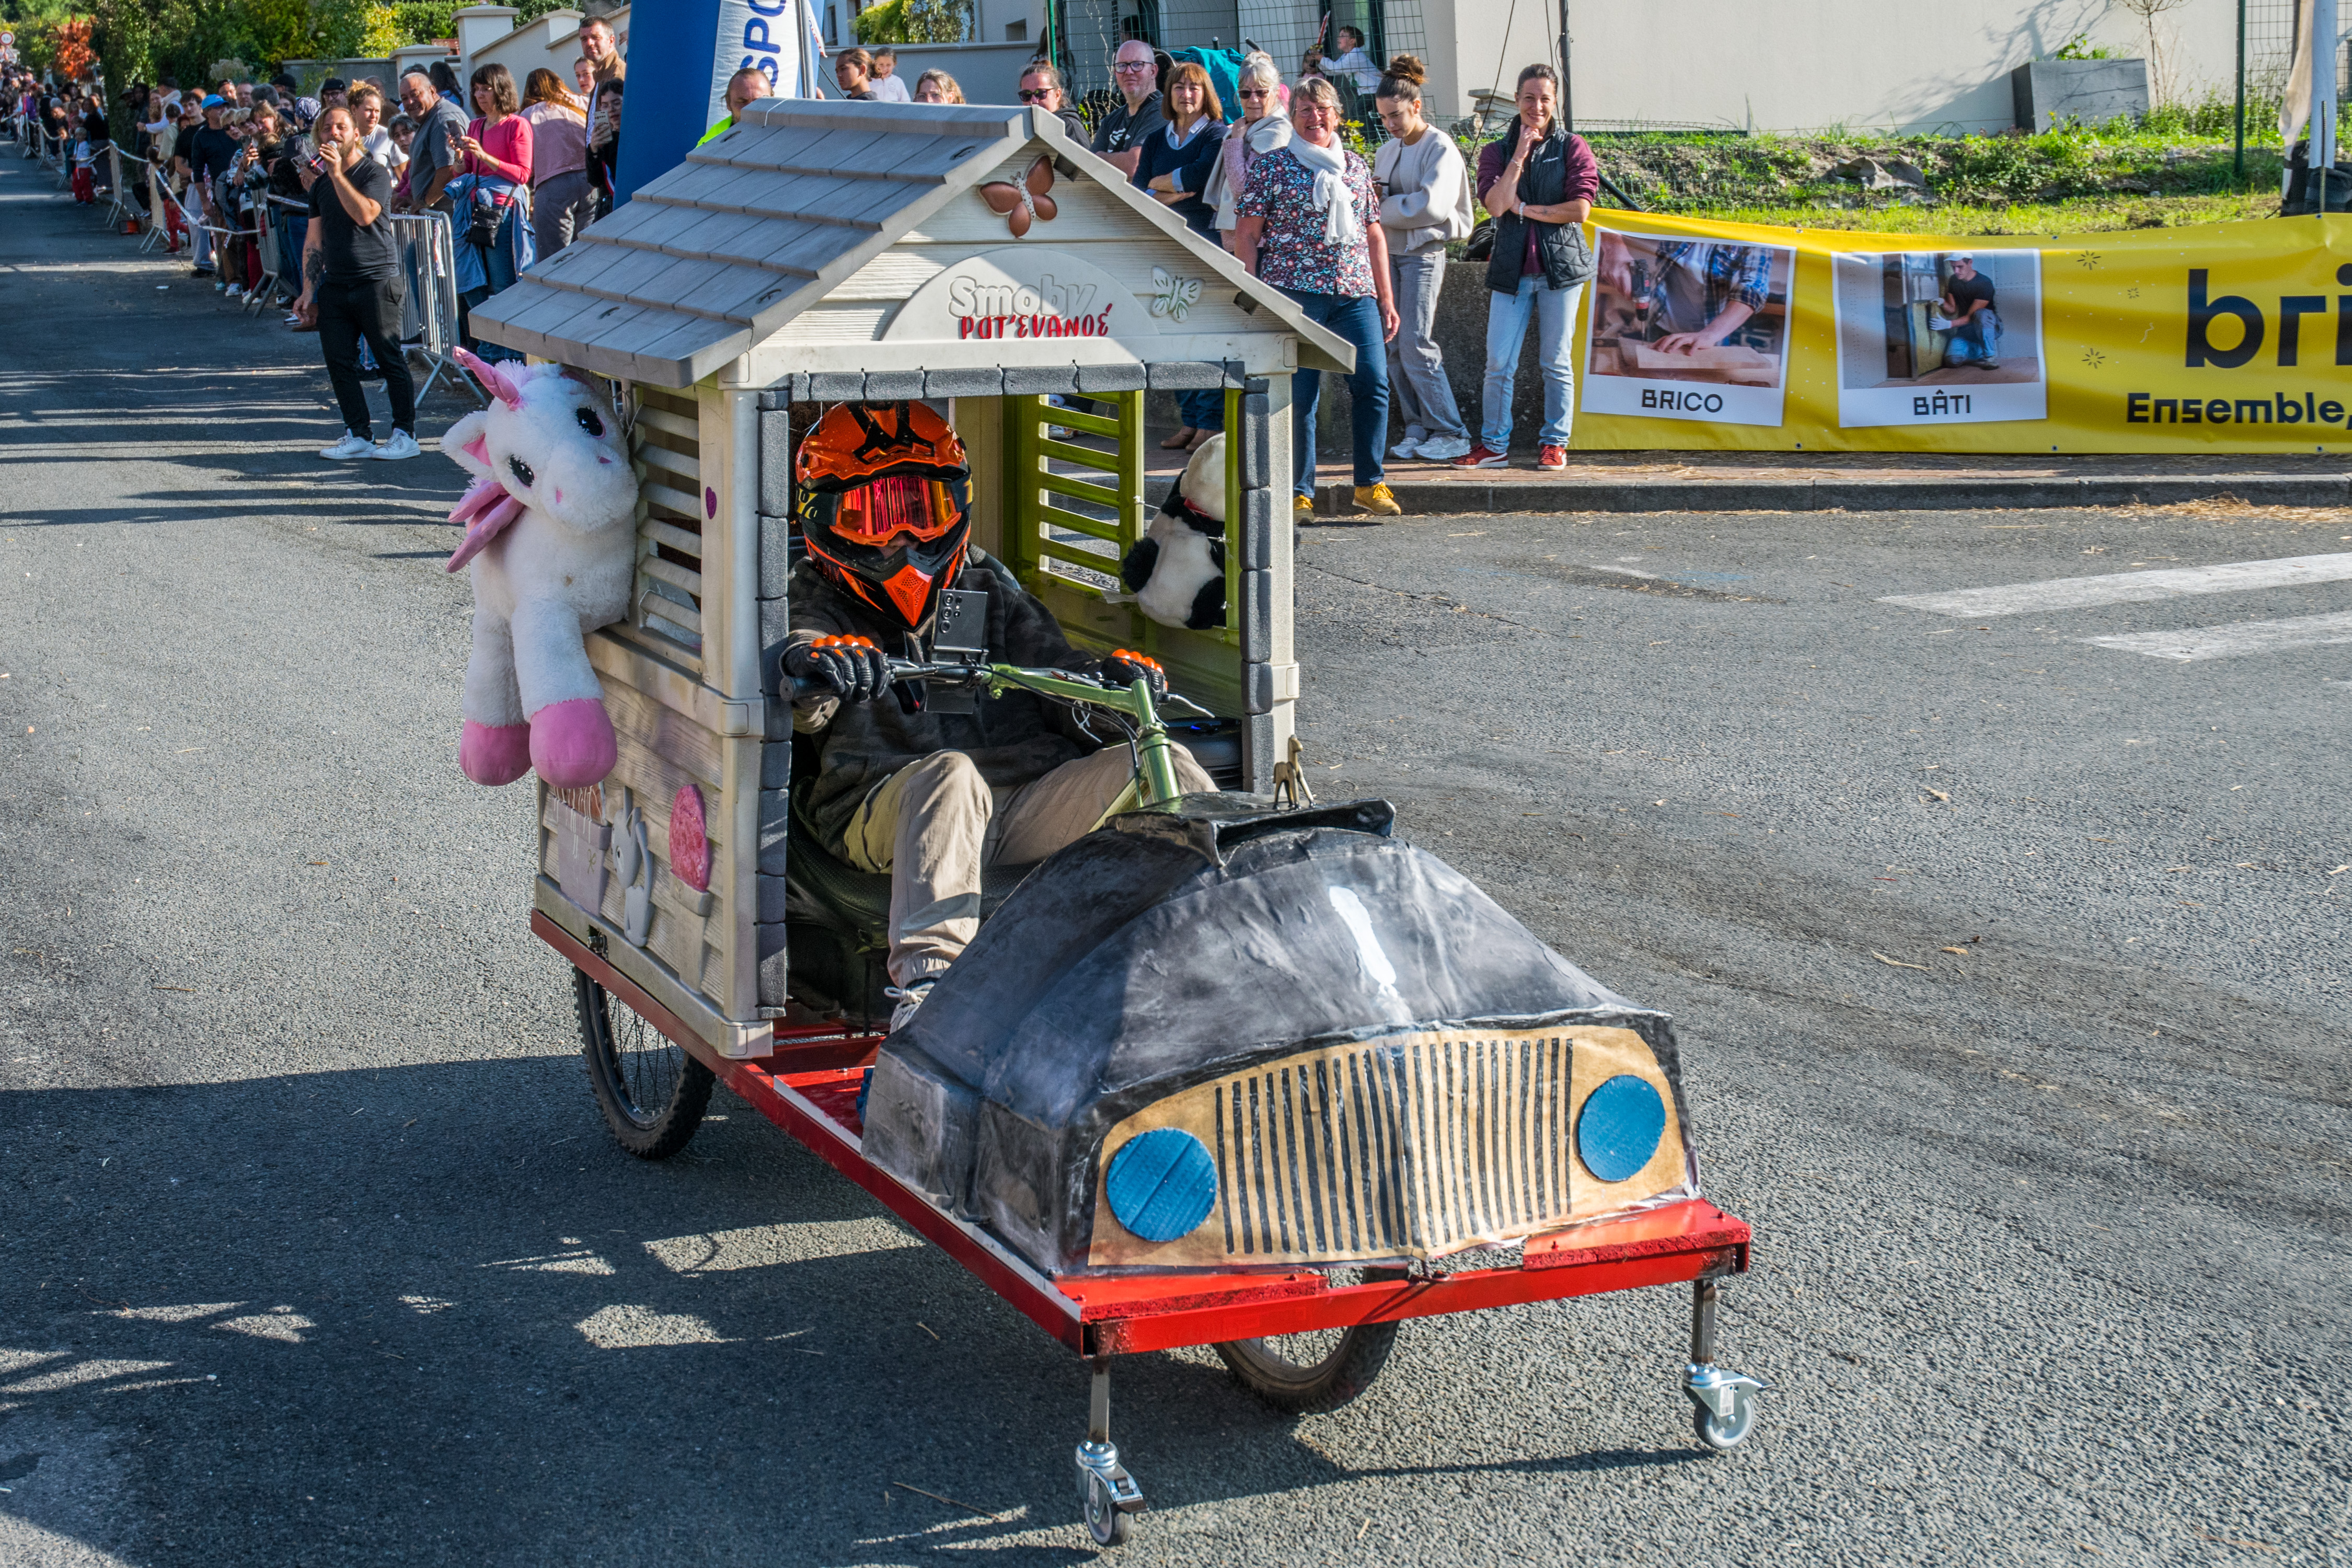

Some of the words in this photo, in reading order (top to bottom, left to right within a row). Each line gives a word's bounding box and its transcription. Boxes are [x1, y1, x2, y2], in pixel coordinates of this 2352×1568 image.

[949, 274, 1097, 321] Smoby
[1641, 389, 1723, 413] BRICO
[1913, 389, 1971, 416] BÂTI
